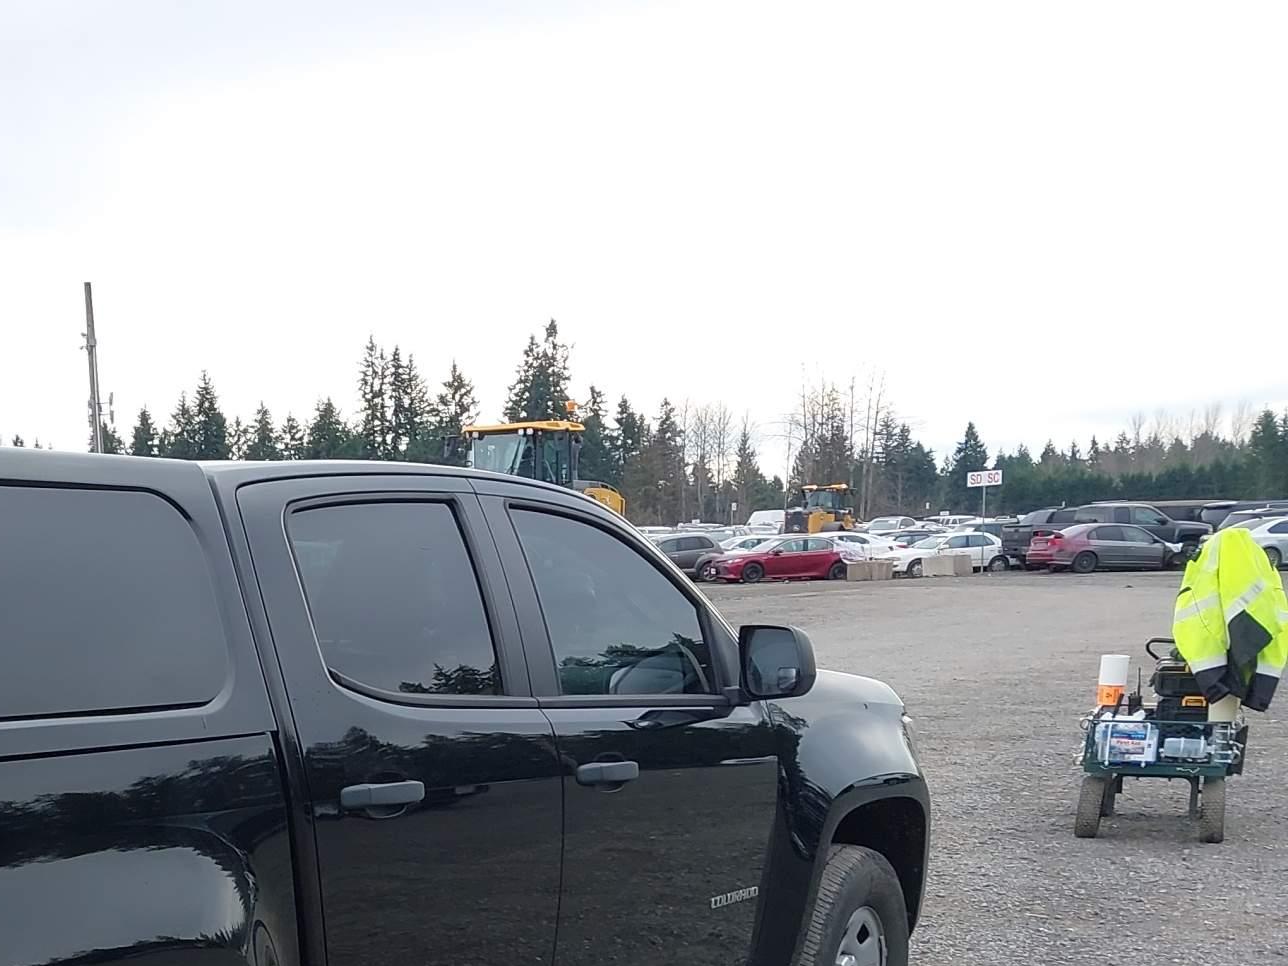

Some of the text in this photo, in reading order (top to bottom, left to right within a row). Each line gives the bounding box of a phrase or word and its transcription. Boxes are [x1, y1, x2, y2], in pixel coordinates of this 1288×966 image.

[970, 471, 1000, 485] SD SC
[710, 886, 759, 909] COLORADO
